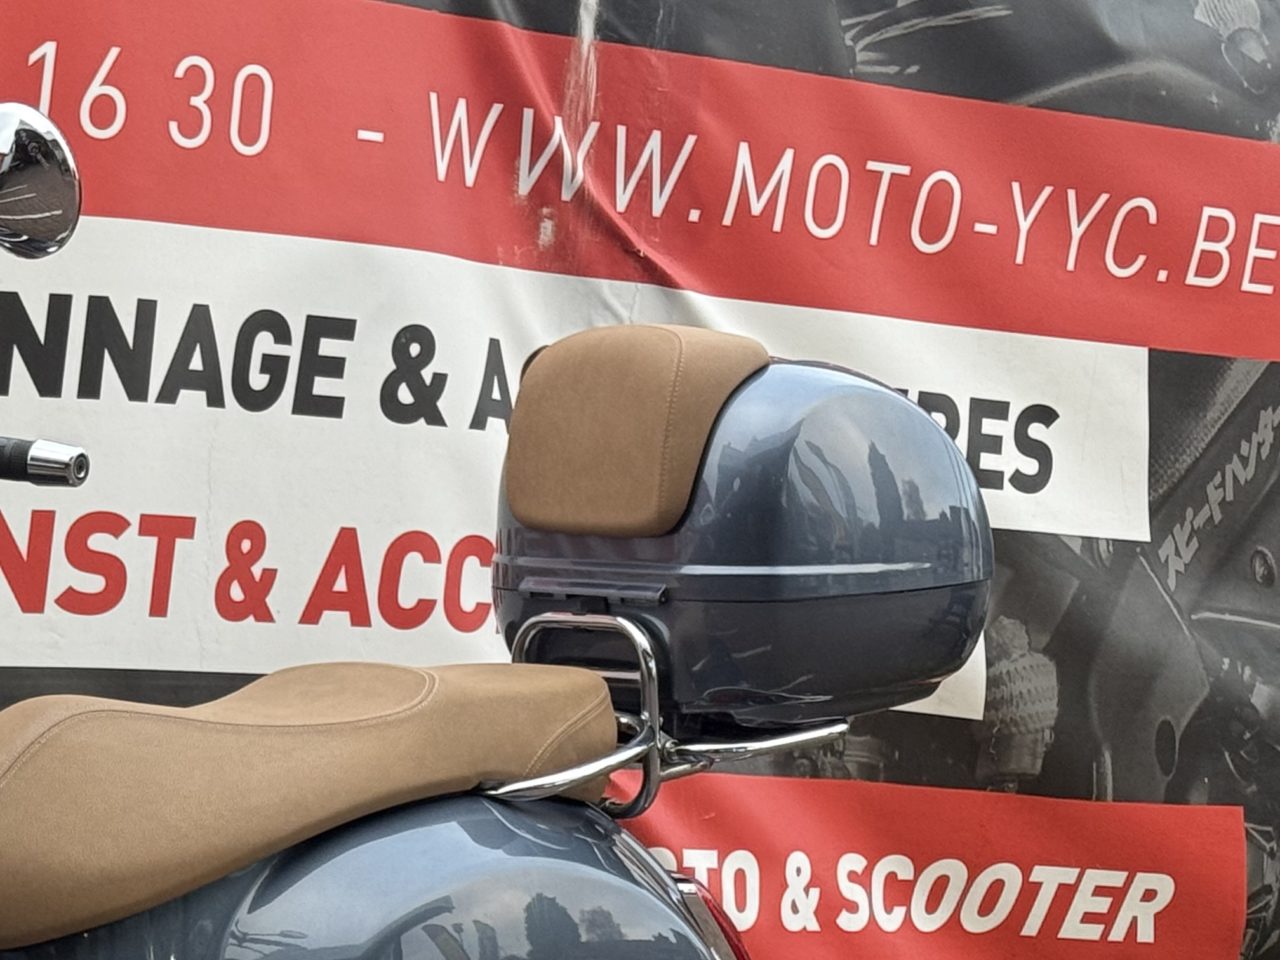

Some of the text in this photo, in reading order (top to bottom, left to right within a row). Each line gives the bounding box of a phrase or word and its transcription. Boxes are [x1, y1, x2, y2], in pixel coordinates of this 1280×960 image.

[25, 41, 126, 140] 16
[168, 55, 273, 156] 30
[428, 91, 1280, 295] WWW.MOTO-YYC.BE
[380, 324, 448, 427] &
[215, 520, 277, 624] &
[780, 850, 821, 932] &
[835, 854, 1176, 944] SCOOTER
